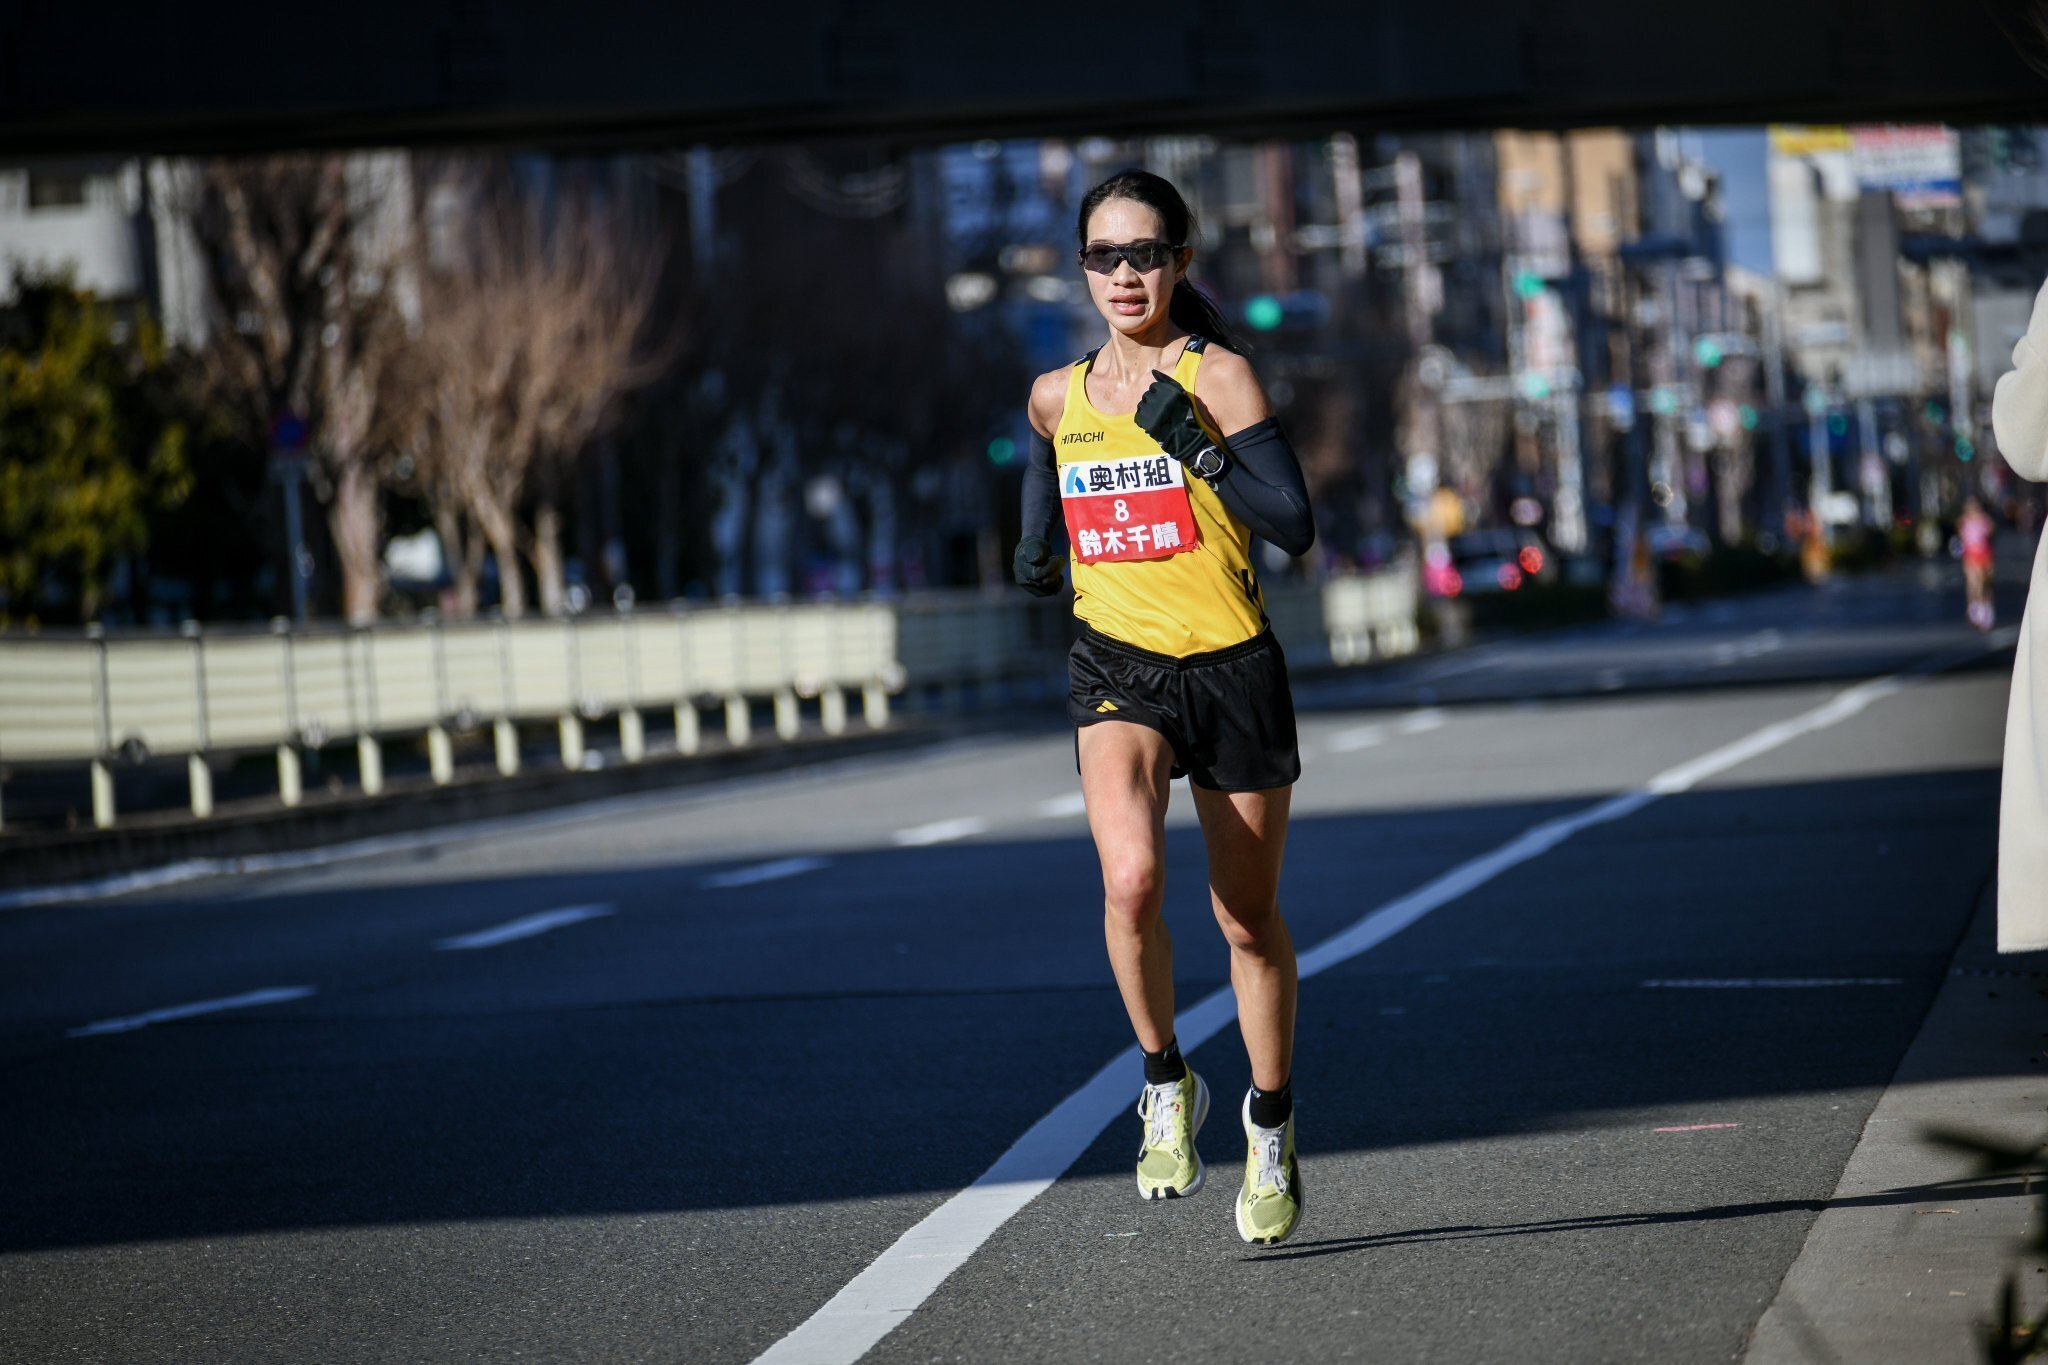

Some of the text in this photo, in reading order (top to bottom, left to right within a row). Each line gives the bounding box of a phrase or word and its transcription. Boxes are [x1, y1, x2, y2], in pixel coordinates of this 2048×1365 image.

[1061, 431, 1105, 445] HITACHI
[1089, 458, 1173, 492] 奥村組
[1113, 499, 1130, 522] 8
[1077, 521, 1181, 557] 鈴木千晴
